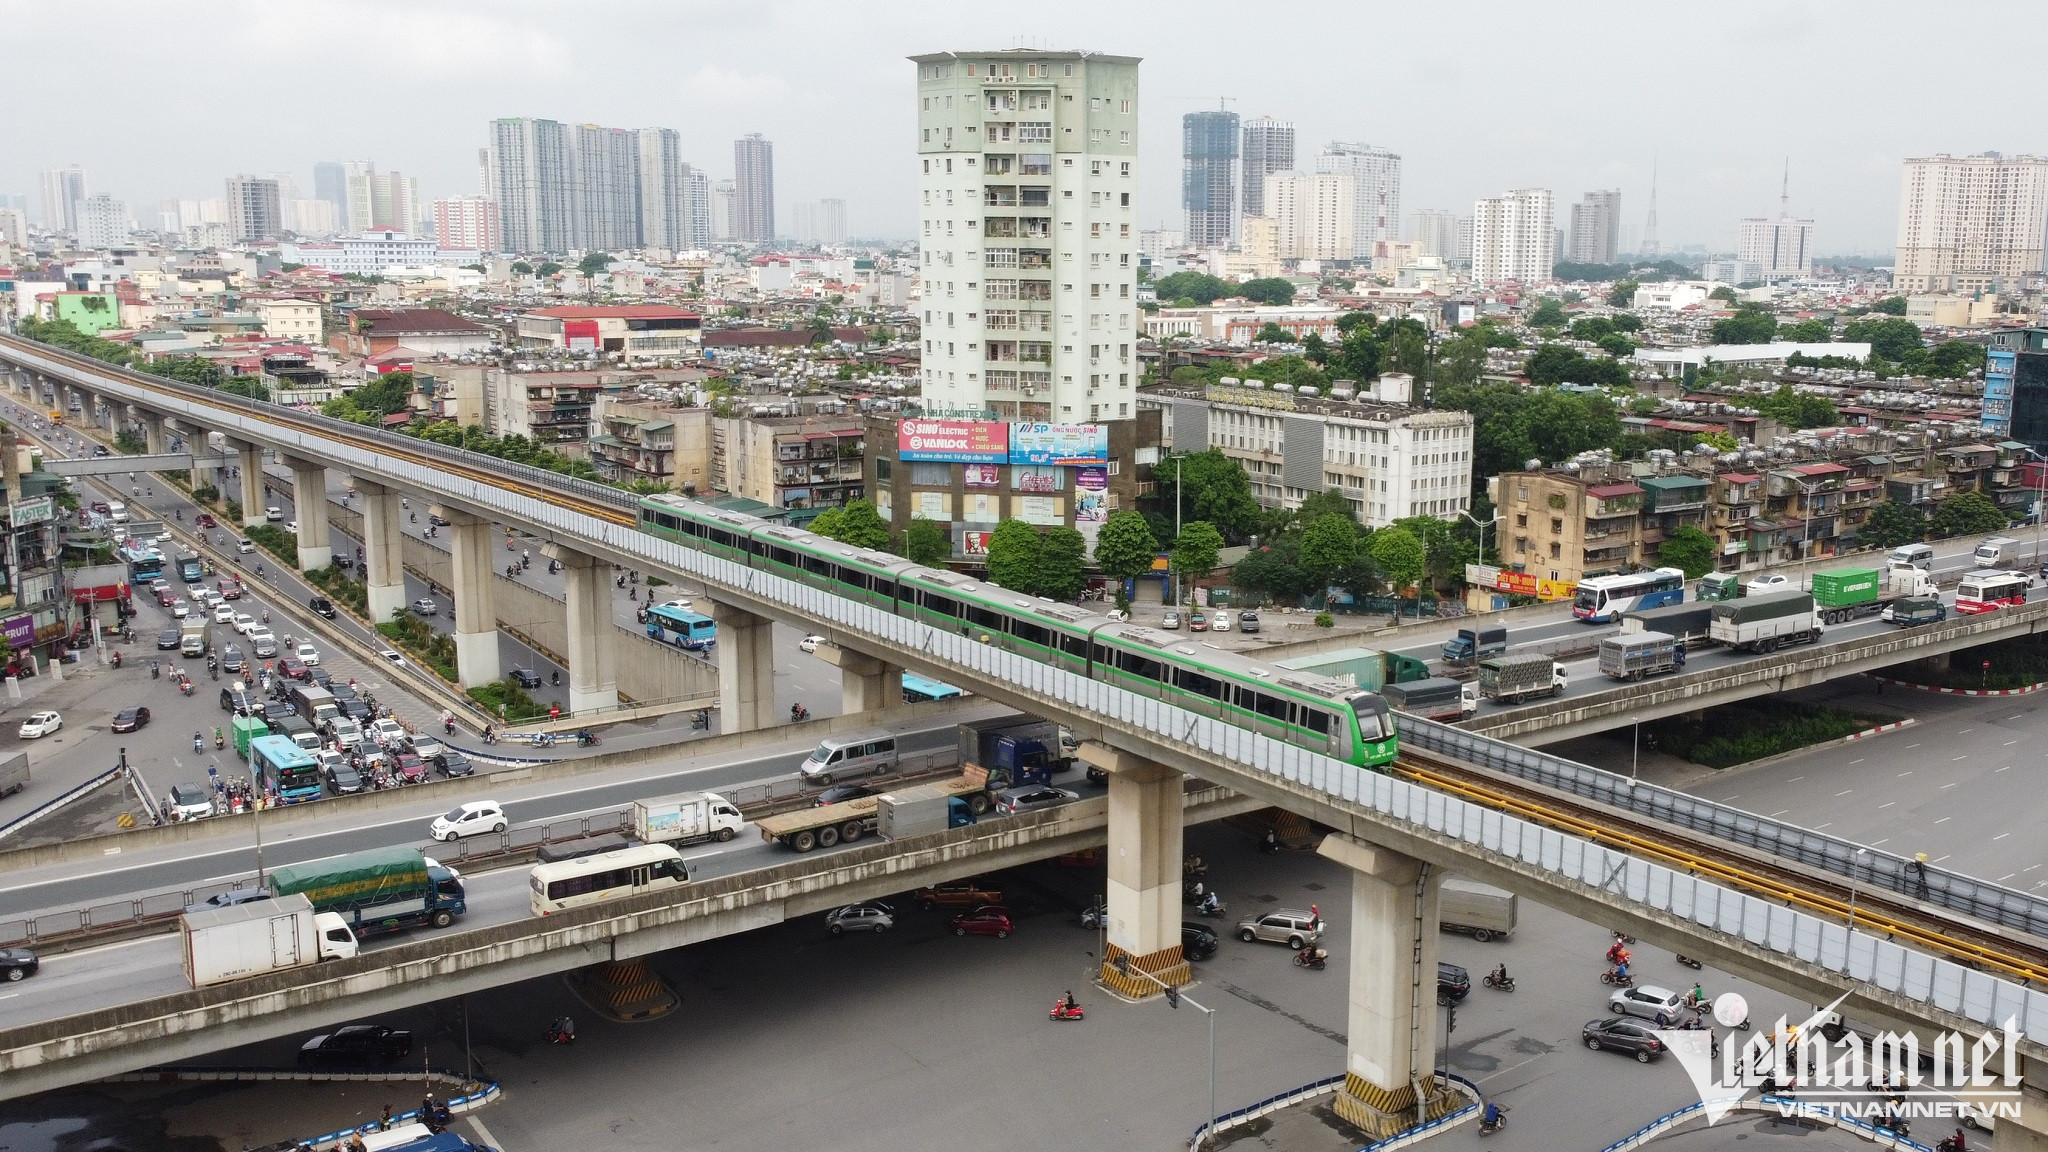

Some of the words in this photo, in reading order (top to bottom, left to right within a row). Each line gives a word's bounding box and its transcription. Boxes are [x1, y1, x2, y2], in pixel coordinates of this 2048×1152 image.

[916, 424, 938, 435] SINO
[938, 428, 969, 436] ELECTRIC
[1033, 425, 1049, 434] SP
[923, 438, 969, 450] VANLOCK
[4, 625, 30, 639] FRUIT
